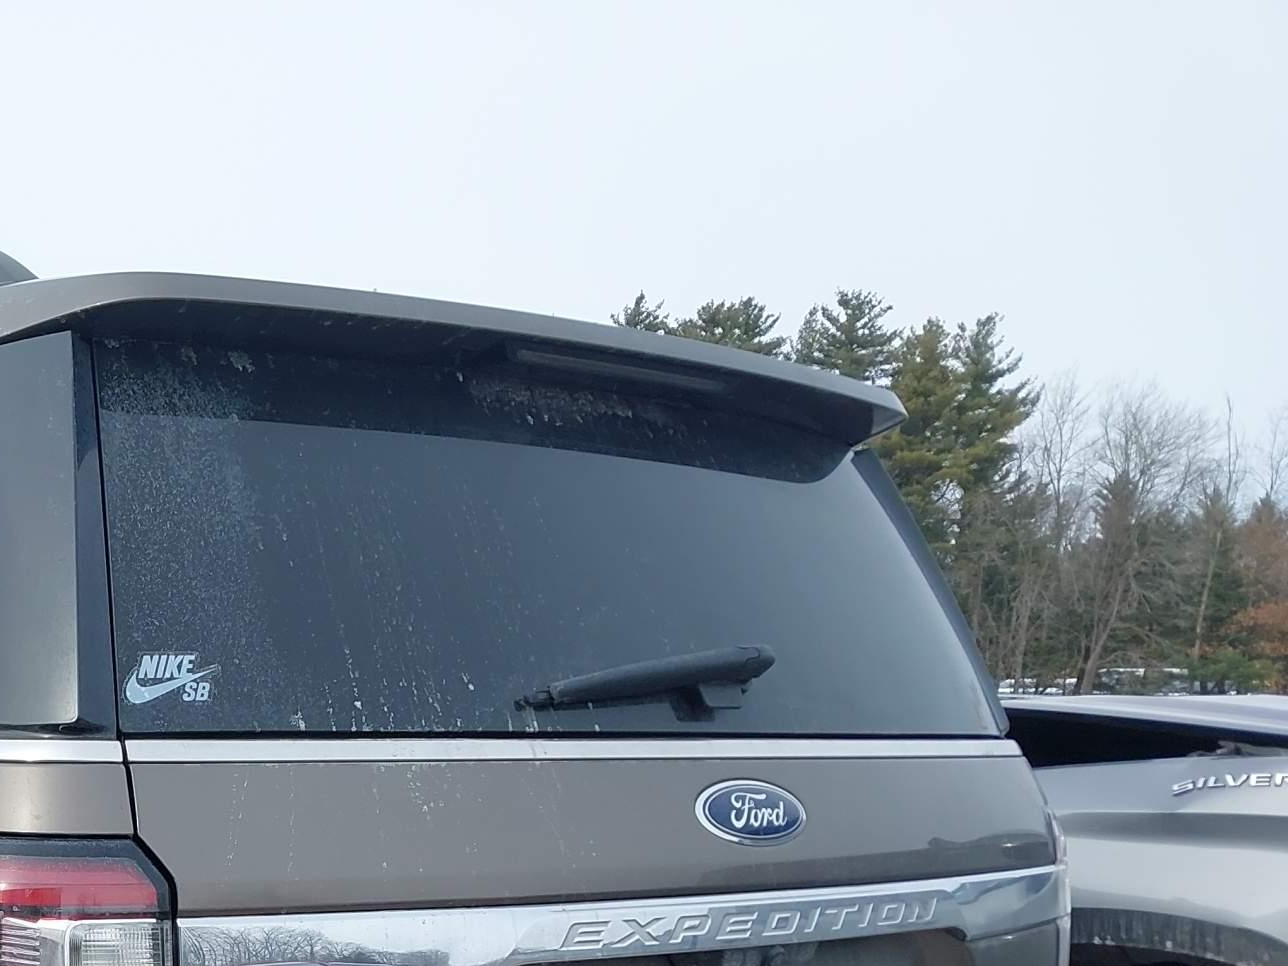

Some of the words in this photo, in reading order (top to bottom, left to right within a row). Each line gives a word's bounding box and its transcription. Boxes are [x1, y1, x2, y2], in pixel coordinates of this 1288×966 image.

[138, 655, 195, 679] NIKE
[182, 683, 210, 702] SB
[730, 792, 787, 828] Ford
[560, 899, 938, 950] EXPEDITION
